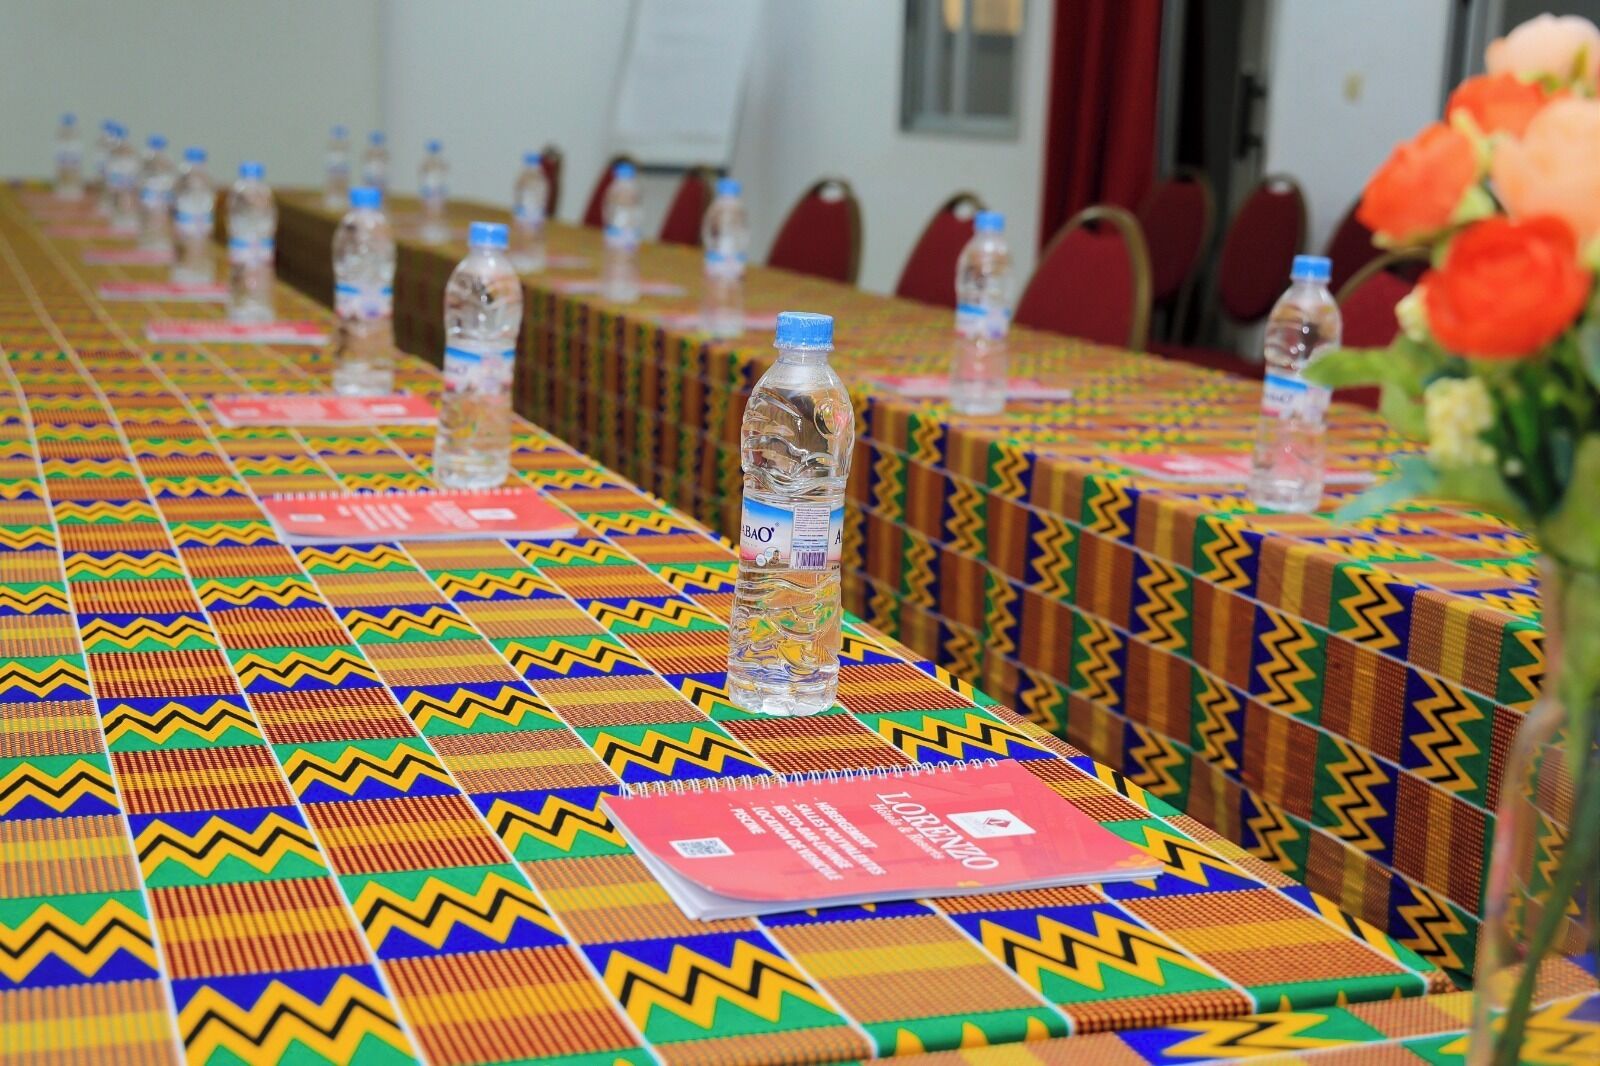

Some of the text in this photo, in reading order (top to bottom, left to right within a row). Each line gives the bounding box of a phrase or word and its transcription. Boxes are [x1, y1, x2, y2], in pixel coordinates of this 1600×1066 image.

[730, 807, 766, 835] PISCINE
[752, 806, 797, 842] LOCATION
[786, 838, 807, 851] DE
[773, 805, 854, 869] RESTO-BAR-LOUNGE
[794, 803, 887, 876] SALLES POLYVALENTES
[876, 791, 999, 870] LORENZO
[906, 832, 945, 860] Resorts
